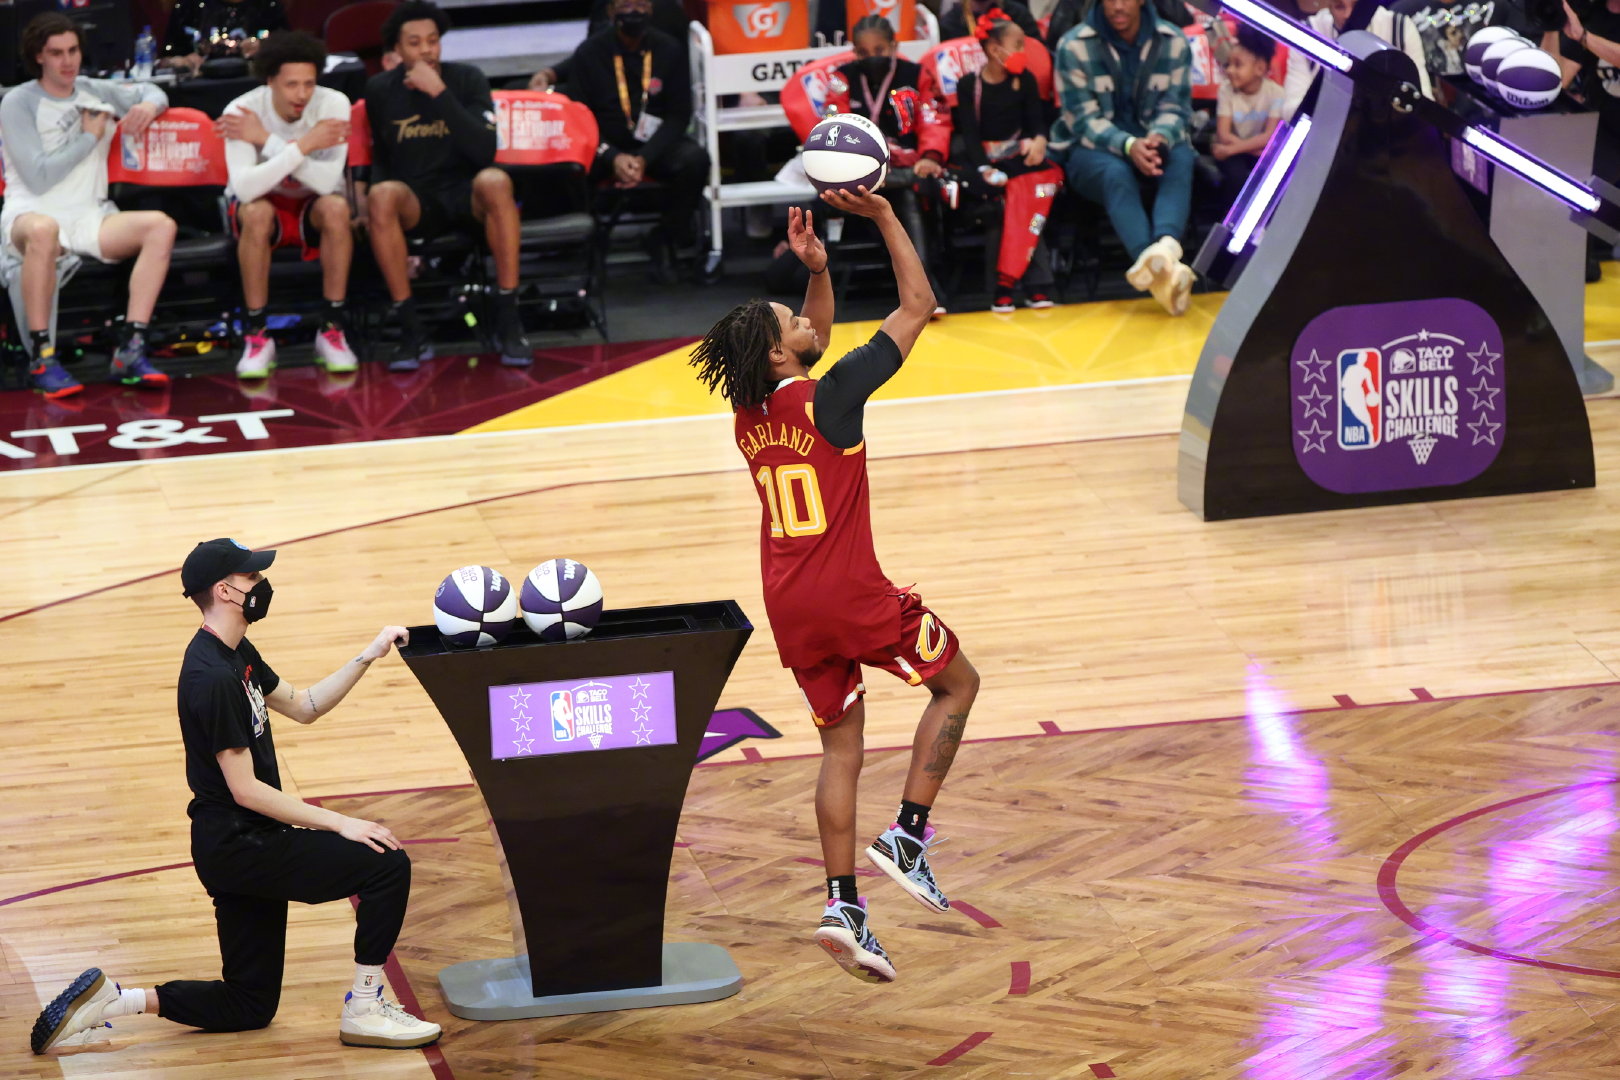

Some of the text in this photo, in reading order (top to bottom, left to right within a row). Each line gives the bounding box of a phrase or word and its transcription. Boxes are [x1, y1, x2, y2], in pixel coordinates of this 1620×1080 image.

[752, 59, 813, 82] GAT
[148, 142, 201, 158] SATURDAY
[1416, 345, 1454, 359] TACO
[1418, 358, 1454, 372] BELL
[1385, 375, 1459, 420] SKILLS
[0, 409, 295, 459] T&T
[1344, 425, 1366, 443] NBA
[1385, 415, 1459, 443] CHALLENGE
[740, 422, 815, 460] GARLAND
[756, 463, 828, 538] 10
[575, 703, 612, 726] SKILLS
[576, 722, 614, 738] CHALLENGE
